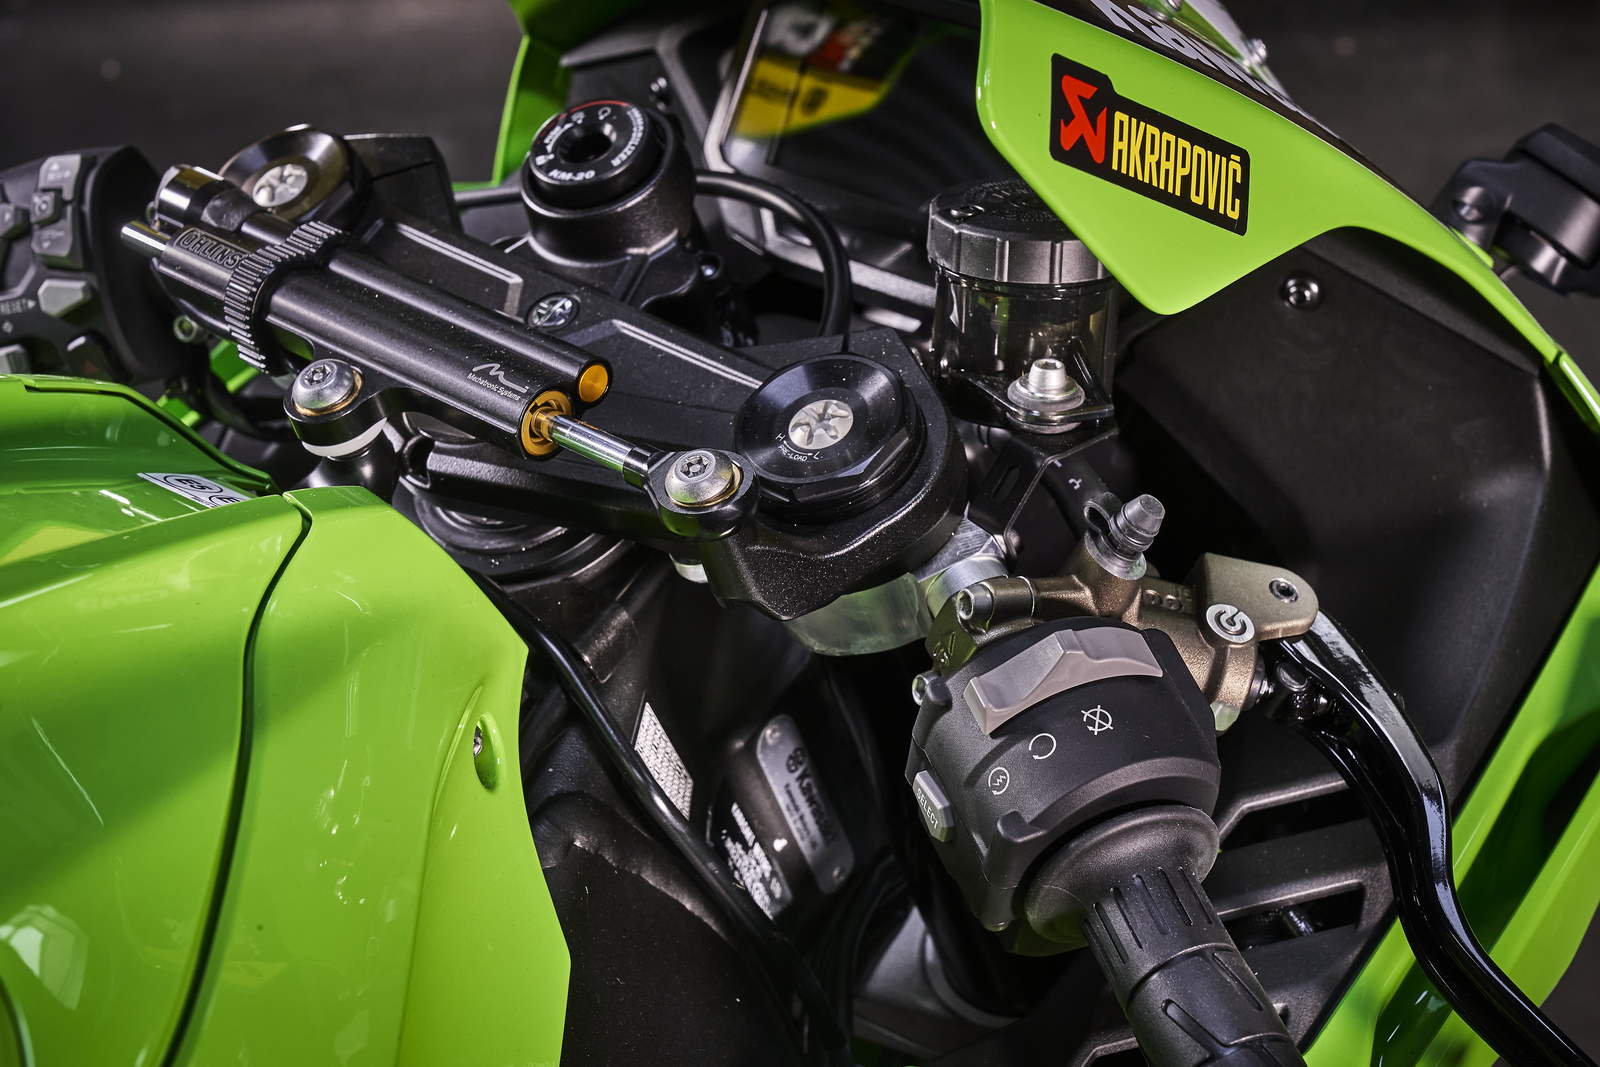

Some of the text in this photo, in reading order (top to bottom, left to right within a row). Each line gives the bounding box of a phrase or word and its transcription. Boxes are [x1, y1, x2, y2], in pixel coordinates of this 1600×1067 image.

[466, 372, 521, 401] Mechatronic Systems
[777, 444, 808, 462] PRE-LOAD
[916, 787, 939, 830] SELECT
